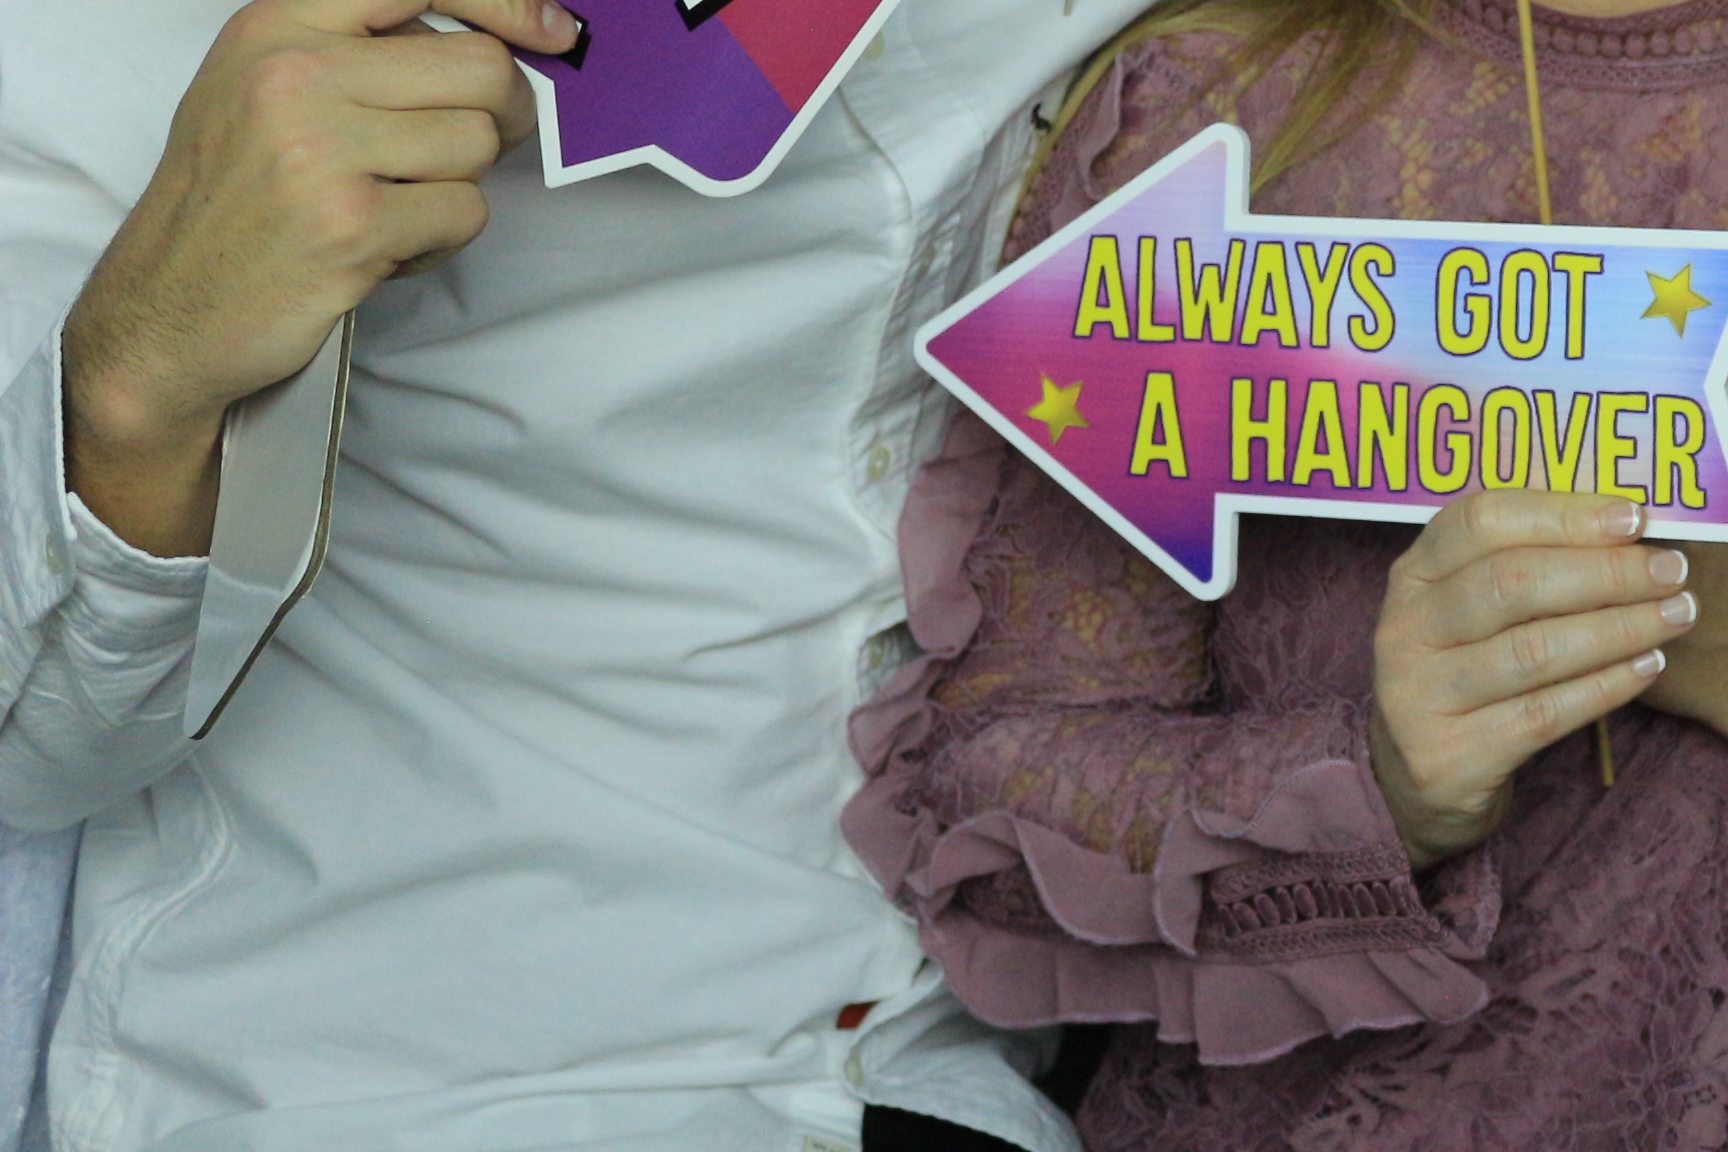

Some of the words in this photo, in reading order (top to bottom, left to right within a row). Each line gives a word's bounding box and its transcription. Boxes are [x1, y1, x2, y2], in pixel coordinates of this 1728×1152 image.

[1072, 234, 1397, 353] ALWAYS
[1435, 247, 1604, 361] GOT
[1129, 370, 1189, 479] A
[1230, 376, 1706, 510] HANGOVER
